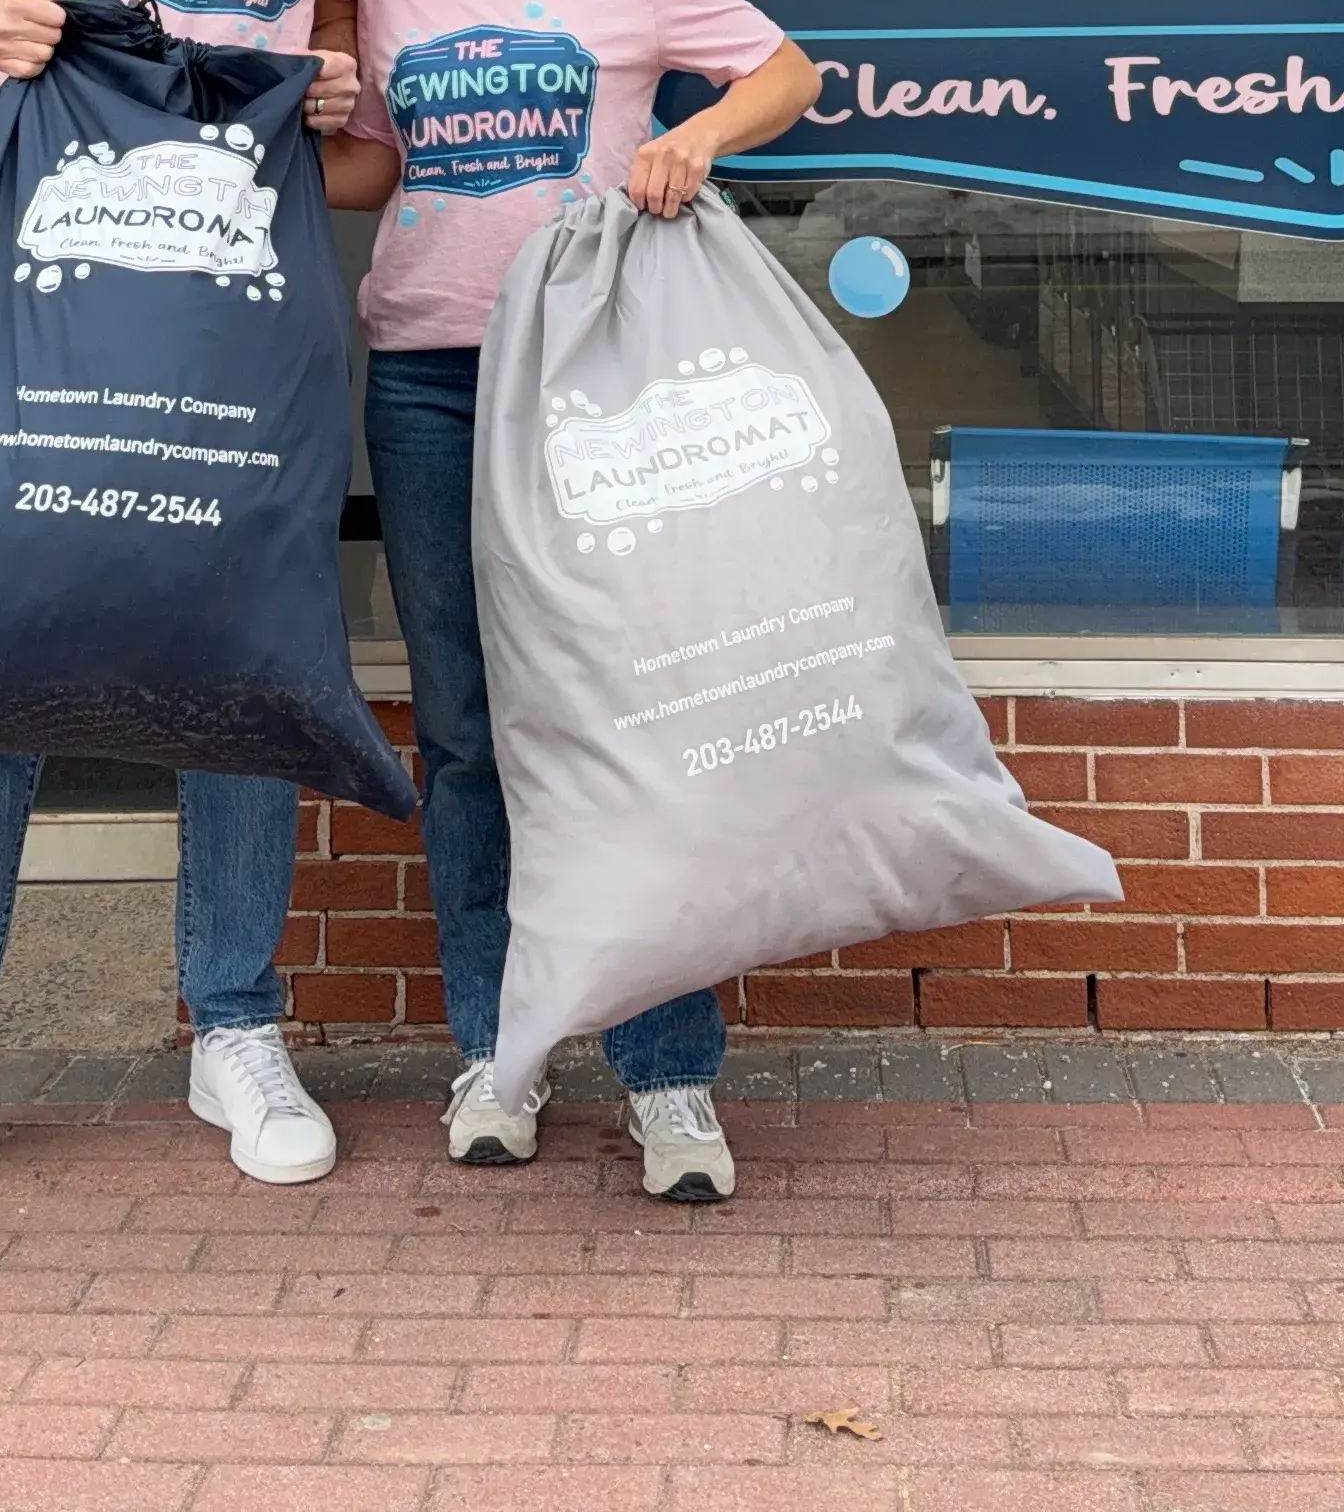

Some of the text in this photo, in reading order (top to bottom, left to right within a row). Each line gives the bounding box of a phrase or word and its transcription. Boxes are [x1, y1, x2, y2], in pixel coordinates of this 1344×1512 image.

[455, 38, 503, 61] THE
[389, 64, 588, 114] NEWINGTON
[403, 108, 583, 148] UNDROMAT
[137, 154, 198, 170] THE
[451, 158, 484, 175] Fresh
[487, 156, 511, 170] and
[514, 152, 559, 172] Bright!
[111, 237, 153, 250] Fresh
[158, 243, 190, 254] and
[103, 388, 176, 414] Laundry
[181, 397, 256, 423] Company
[639, 389, 694, 414] THE
[554, 384, 800, 468] NEWINGTON
[564, 411, 809, 500] LAUNDROMAT
[664, 478, 704, 495] Fresh
[707, 469, 734, 484] and
[15, 483, 222, 527] 203-487-2544
[633, 595, 854, 676] Hometown Laundry Company
[614, 634, 895, 730] www.hometownlaundrycompany.com
[682, 695, 863, 777] 203-487-2544
